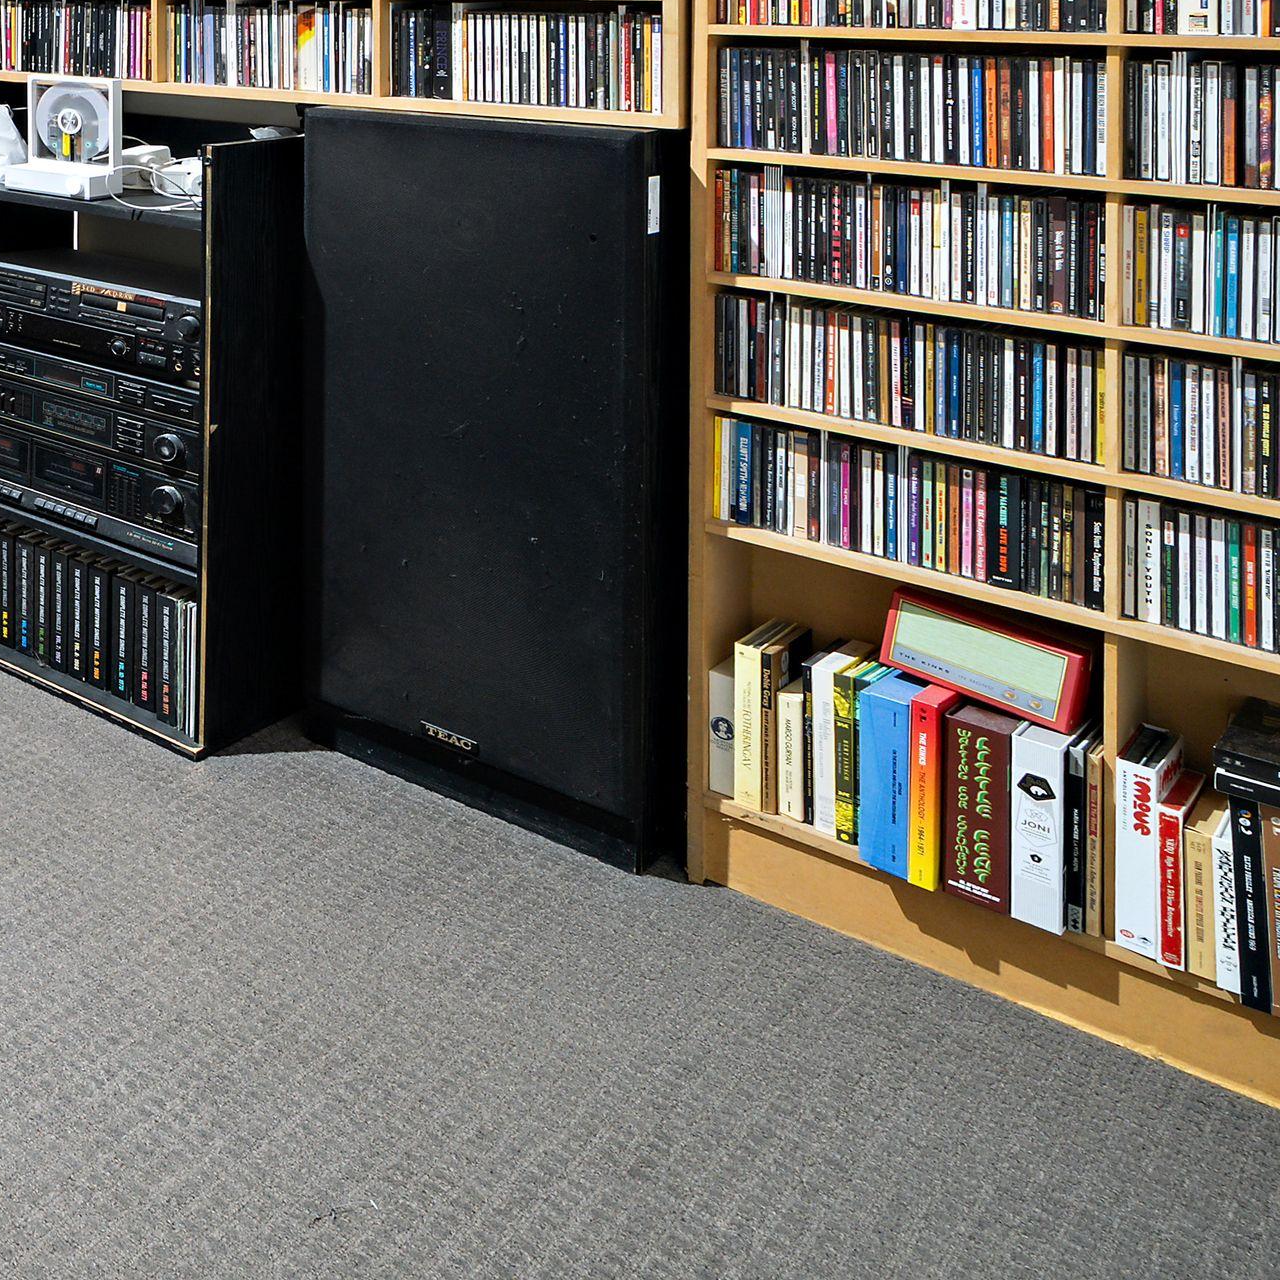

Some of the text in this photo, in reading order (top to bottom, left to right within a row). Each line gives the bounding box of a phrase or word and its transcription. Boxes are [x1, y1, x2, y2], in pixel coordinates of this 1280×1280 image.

[899, 652, 950, 674] THE KINKS
[762, 689, 771, 707] Gray
[425, 725, 472, 751] TEAC
[919, 732, 927, 765] THE KINKS
[918, 772, 926, 820] THE ANTHOLOGY
[1133, 781, 1152, 836] move
[1021, 820, 1050, 833] JONI
